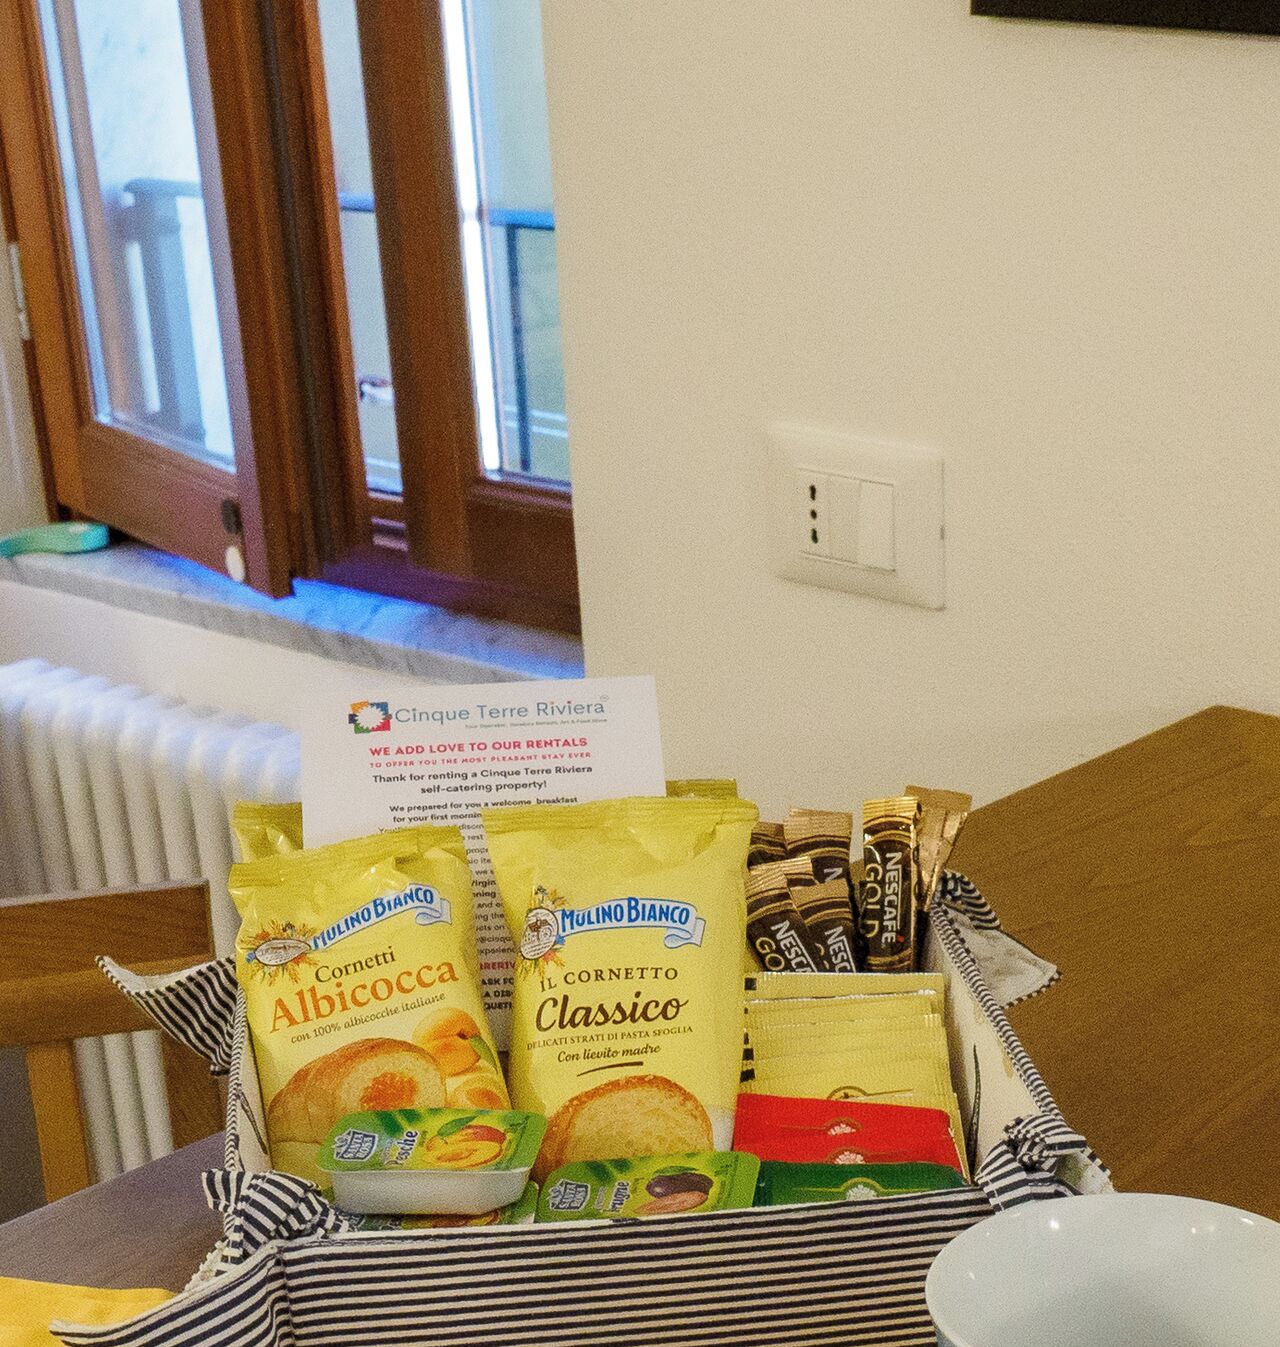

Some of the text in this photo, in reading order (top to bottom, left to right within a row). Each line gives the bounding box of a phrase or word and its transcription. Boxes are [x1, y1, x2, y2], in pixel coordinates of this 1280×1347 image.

[395, 700, 605, 725] Cinque Terre Riviera
[369, 738, 588, 756] WE ADD LOVE TO OUR RENTALS
[491, 754, 537, 762] PLEASANT
[372, 773, 406, 783] Thank
[410, 772, 425, 781] for
[428, 770, 468, 781] renting
[480, 768, 520, 779] Cinque
[524, 767, 552, 776] Terre
[555, 765, 592, 774] Riviera
[420, 780, 547, 794] self-catering property!
[407, 802, 447, 813] prepared
[492, 799, 531, 807] welcome
[536, 796, 577, 805] breakfast
[408, 815, 428, 824] your
[430, 813, 448, 821] first
[451, 812, 483, 820] mornin
[311, 887, 434, 950] MULINO BIANCO
[560, 896, 690, 932] MULINO BIANCO
[755, 937, 786, 971] GO
[824, 925, 856, 973] NESC
[314, 945, 397, 983] Cornetti
[540, 967, 679, 993] IL CORNETTO
[269, 961, 460, 1033] Albicocca
[291, 992, 447, 1044] con 100% albicocche italiane
[535, 990, 689, 1033] Classico
[527, 1025, 693, 1051] DELICATI STRATI DI PASTA SFOGLIA
[557, 1043, 661, 1063] Con lievito madre
[385, 1130, 418, 1166] Pesche
